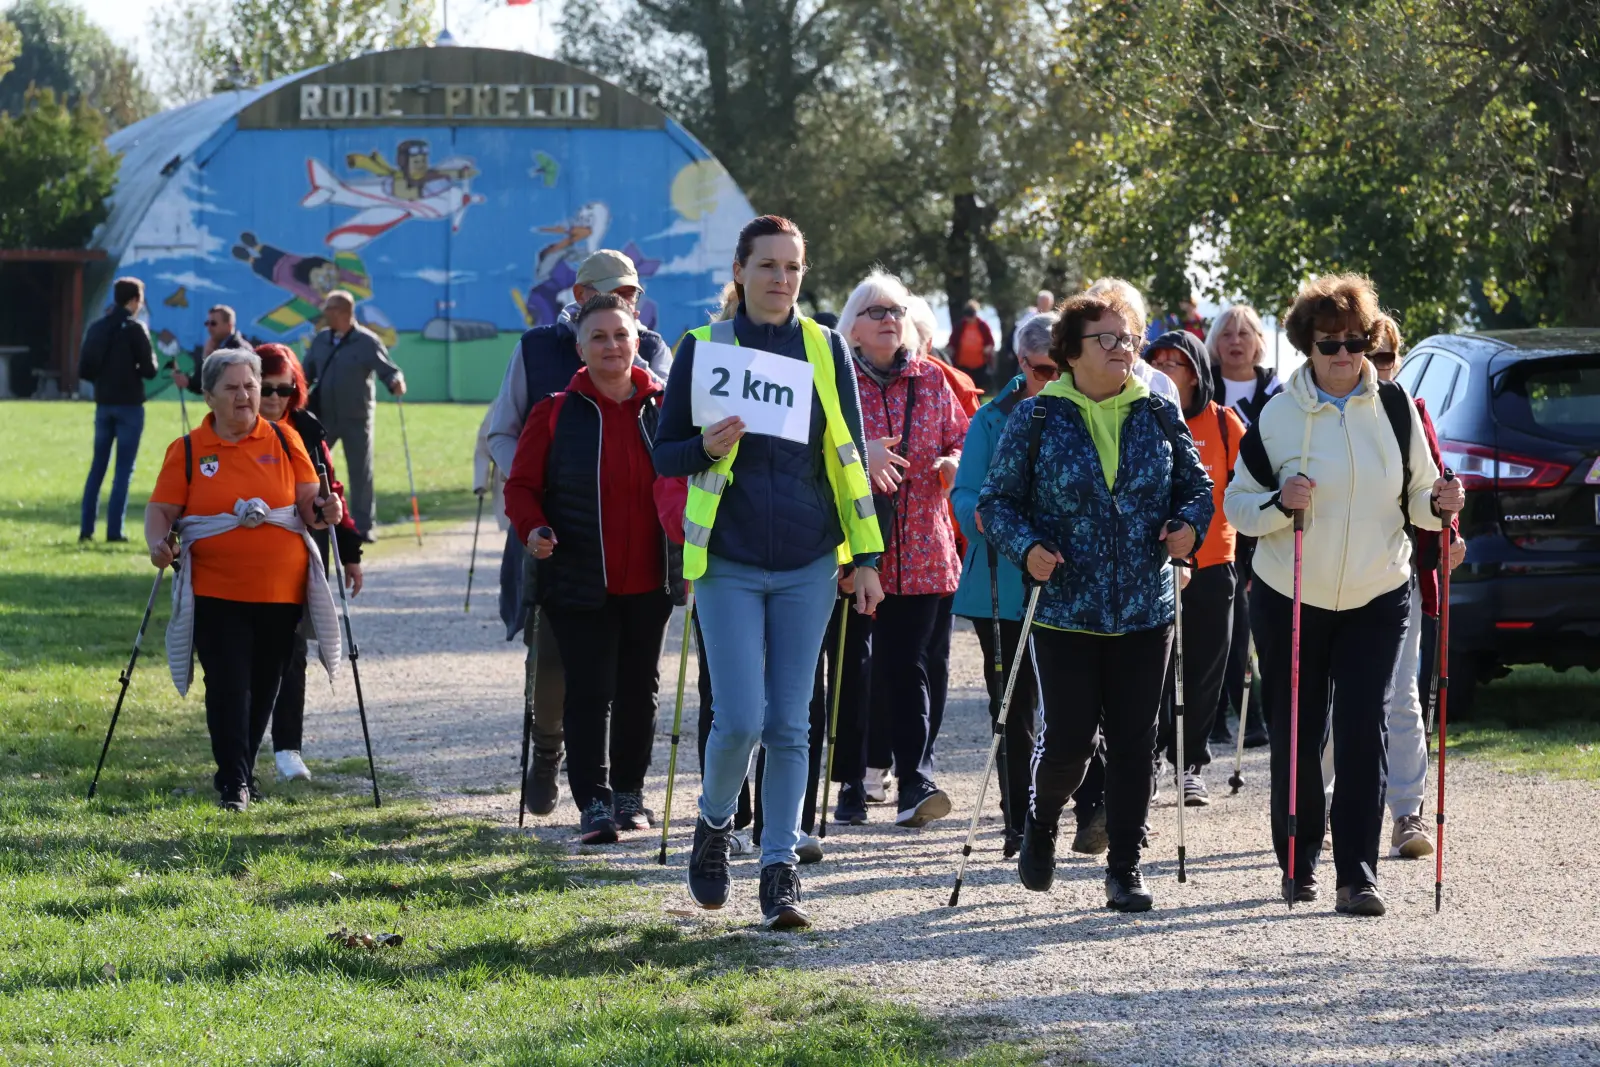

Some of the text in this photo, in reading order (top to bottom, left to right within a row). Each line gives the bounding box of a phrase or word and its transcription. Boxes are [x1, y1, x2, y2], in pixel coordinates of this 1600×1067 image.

[300, 84, 600, 120] RODE PRELOG
[709, 367, 794, 408] 2 km
